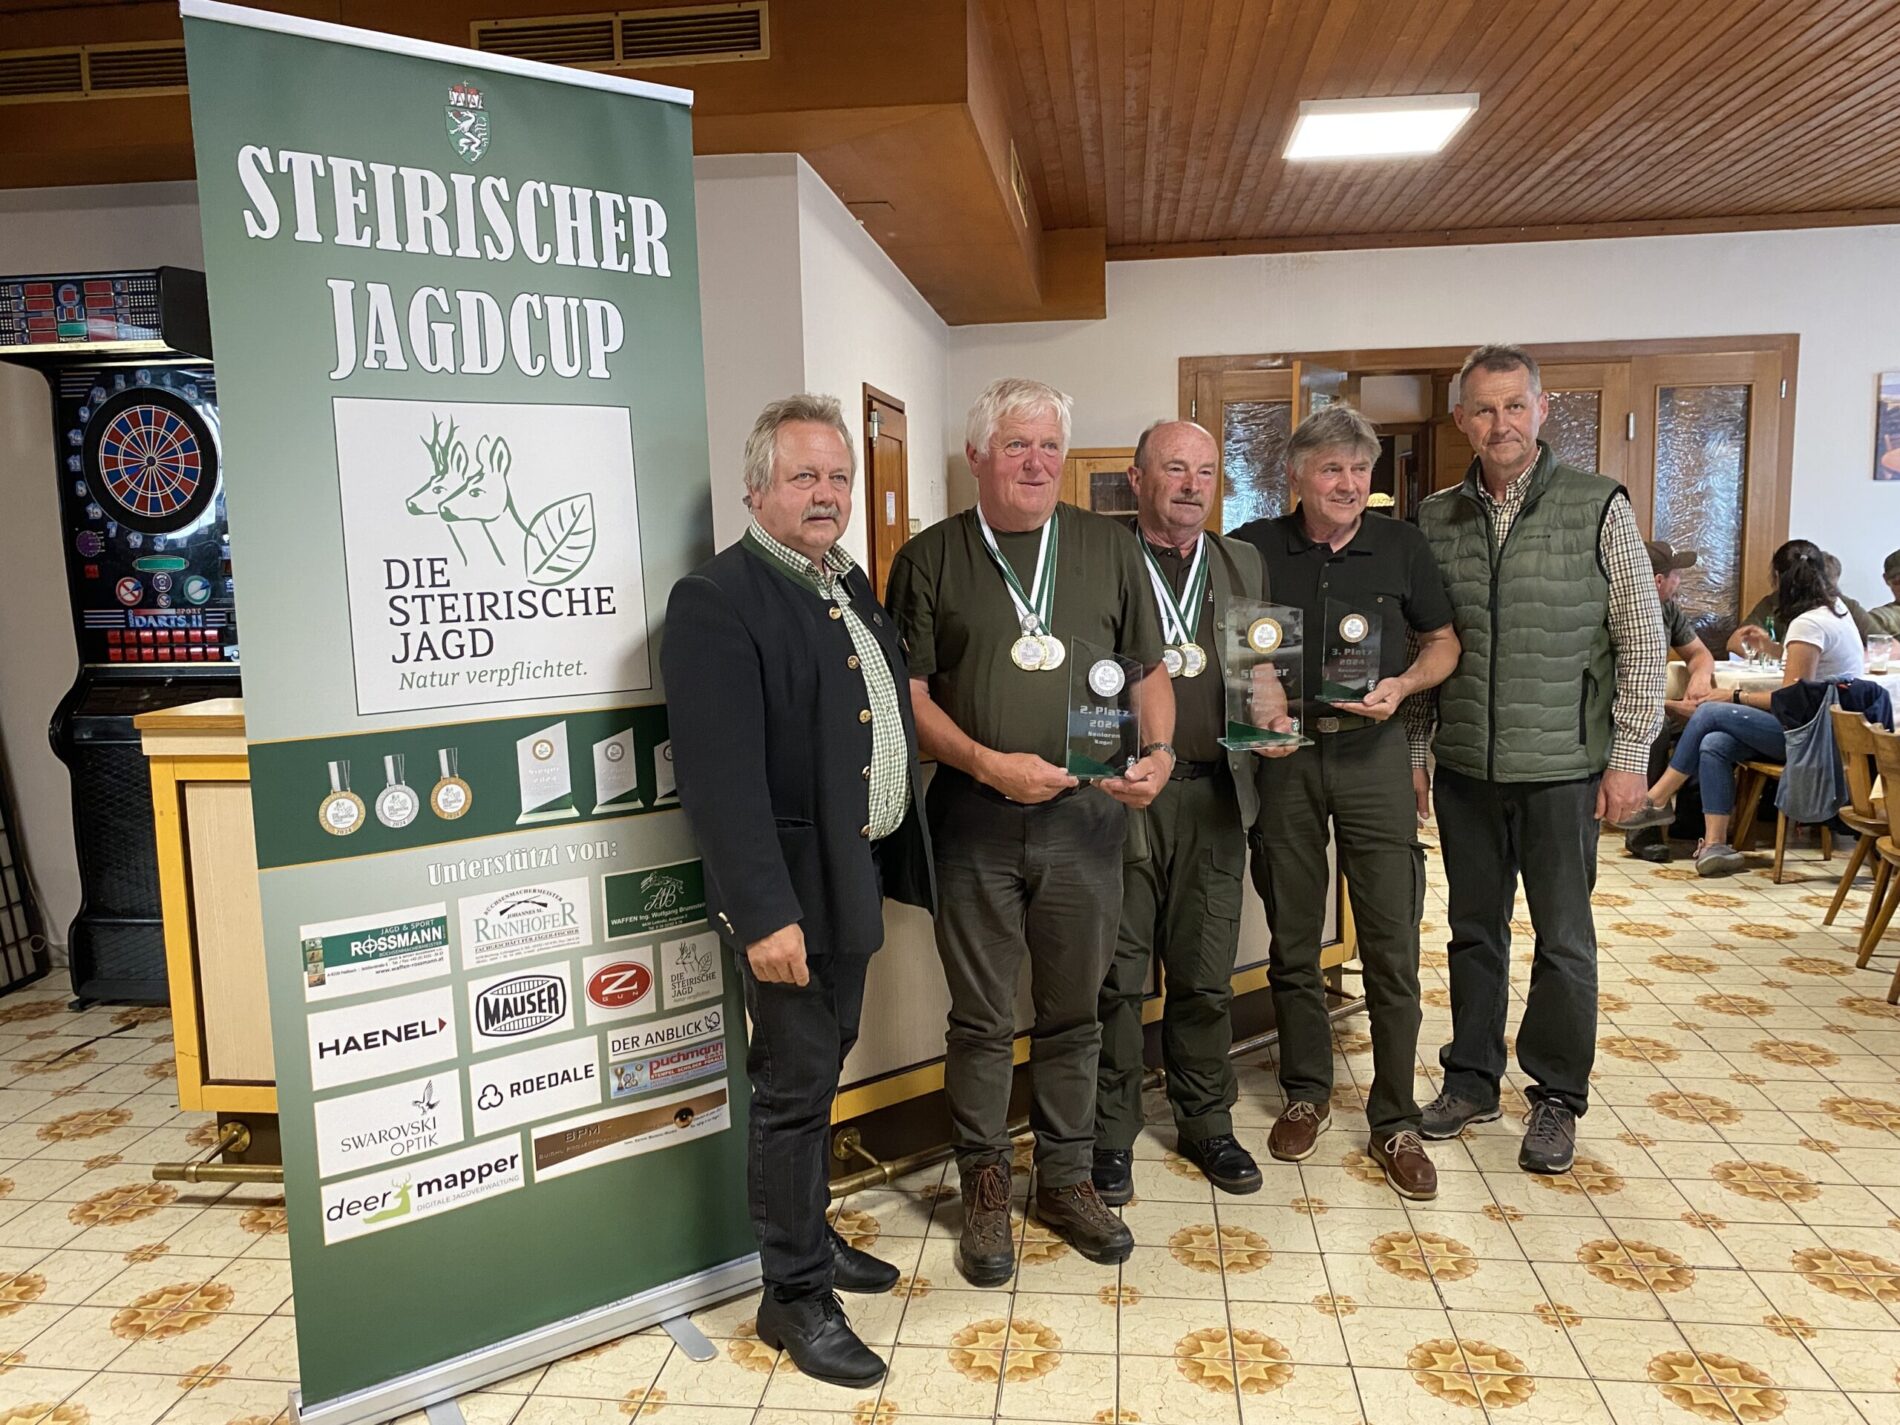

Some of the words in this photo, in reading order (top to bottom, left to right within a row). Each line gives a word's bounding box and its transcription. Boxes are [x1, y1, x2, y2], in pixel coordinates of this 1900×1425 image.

[237, 144, 671, 277] STEIRISCHER
[326, 278, 625, 380] JAGDCUP
[79, 406, 90, 423] 9
[383, 557, 450, 590] DIE
[135, 615, 187, 628] DARTS
[389, 586, 617, 627] STEIRISCHE
[391, 628, 494, 663] JAGD
[399, 669, 459, 690] Natur
[466, 660, 588, 687] verpflichtet.
[1080, 705, 1092, 714] 2.
[1096, 706, 1130, 718] Platz
[1089, 719, 1120, 729] 2024
[428, 844, 559, 887] Unterstützt
[565, 840, 617, 863] von:
[381, 926, 399, 935] JAGD
[410, 919, 435, 929] SPORT
[474, 902, 578, 943] RINNHOFER
[507, 909, 536, 919] JOHANNES
[611, 915, 638, 925] WAFFEN
[351, 925, 443, 957] ROSSMANN
[601, 969, 638, 995] Z
[670, 972, 684, 982] DIE
[671, 972, 717, 990] STEIRISCHE
[672, 987, 693, 998] JAGD
[483, 982, 560, 1031] MAUSER
[318, 1020, 437, 1059] HAENEL
[611, 1035, 640, 1053] DER
[645, 1020, 702, 1046] ANBLICK
[510, 1063, 595, 1098] ROEDALE
[341, 1116, 437, 1152] SWAROVSKI
[391, 1133, 439, 1156] OPTIK
[565, 1124, 601, 1143] BPM
[326, 1190, 391, 1222] deer
[417, 1153, 519, 1197] mapper
[417, 1195, 451, 1211] DIGITALE
[452, 1175, 520, 1201] JAGDVERWALTUNG
